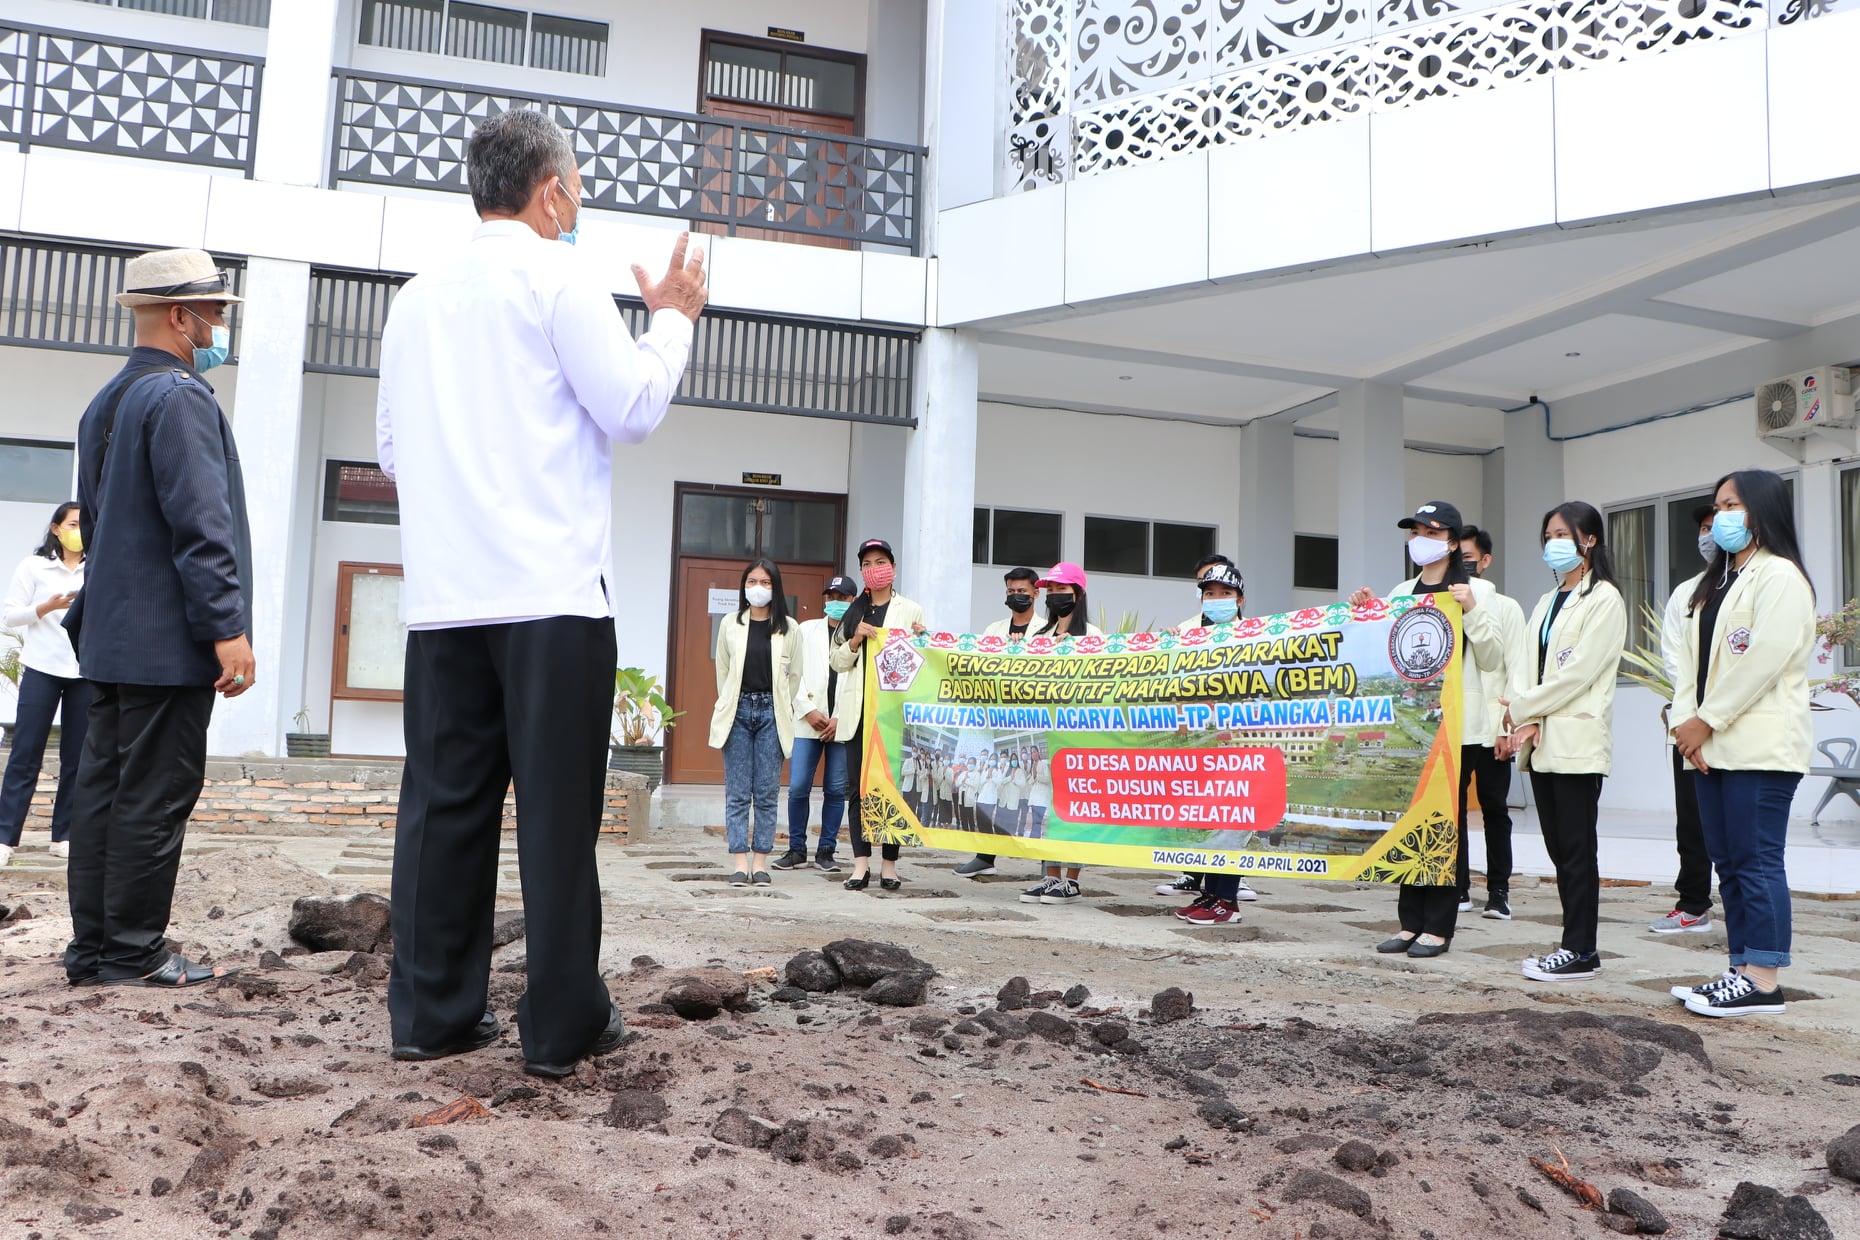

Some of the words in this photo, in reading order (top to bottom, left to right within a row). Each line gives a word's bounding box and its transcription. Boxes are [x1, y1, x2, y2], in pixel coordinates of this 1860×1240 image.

[947, 653, 1081, 678] PENGABDIAN
[1082, 654, 1169, 679] KEPADA
[1174, 631, 1343, 671] MASYARAKAT
[938, 679, 997, 703] BADAN
[999, 680, 1115, 704] EKSEKUTIF
[1114, 671, 1271, 703] MAHASISWA
[1275, 664, 1357, 698] (BEM)
[904, 703, 986, 727] FAKULTAS
[988, 706, 1052, 730] DHARMA
[1056, 707, 1126, 731] ACARYA
[1129, 704, 1212, 730] IAHN-TP
[1217, 699, 1330, 729] PALANGKA
[1334, 696, 1395, 726] RAYA
[1066, 754, 1084, 770] DI
[1089, 755, 1131, 771] DESA
[1135, 755, 1198, 772] DANAU
[1203, 754, 1266, 772] SADAR
[1068, 778, 1102, 794] KEC.
[1107, 779, 1166, 796] DUSUN
[1171, 780, 1249, 797] SELATAN
[1069, 801, 1106, 818] KAB.
[1110, 803, 1175, 821] BARITO
[1178, 805, 1255, 823] SELATAN
[1153, 851, 1208, 866] TANGGAL
[1211, 854, 1226, 867] 26
[1239, 855, 1254, 869] 28
[1257, 857, 1293, 871] APRIL
[1296, 859, 1328, 873] 2021
